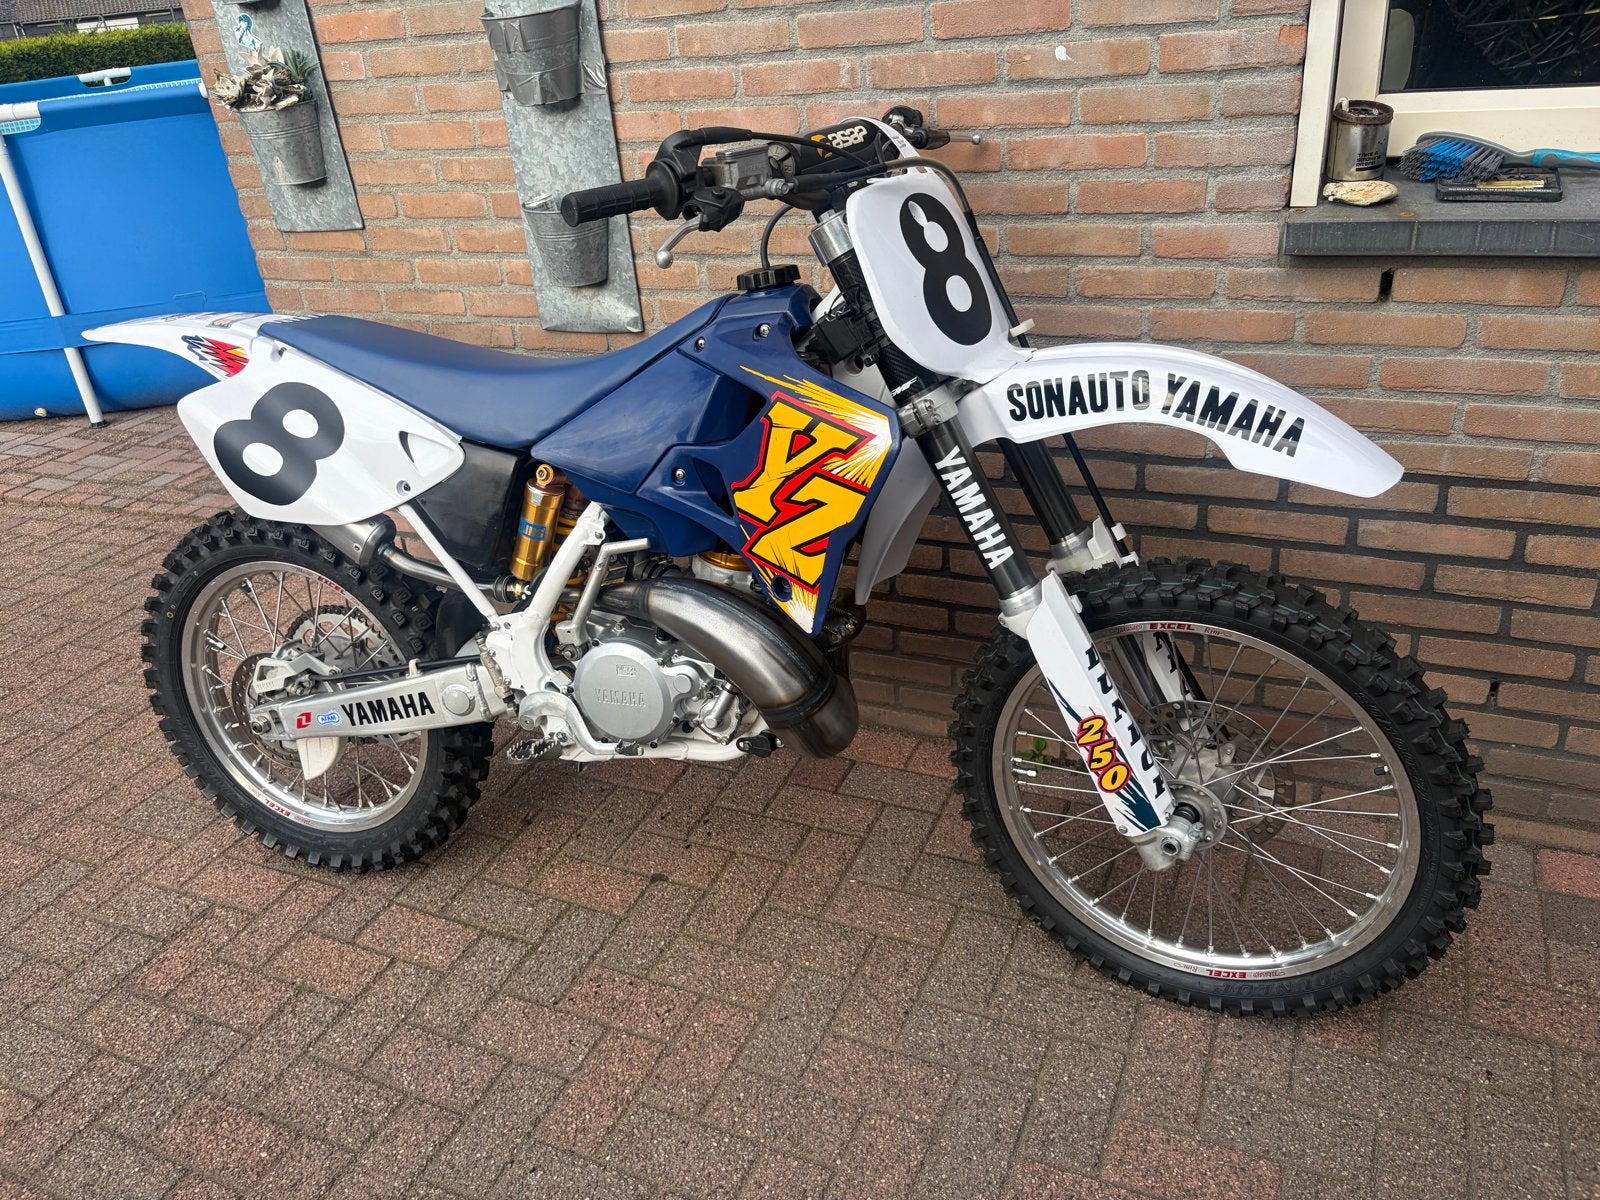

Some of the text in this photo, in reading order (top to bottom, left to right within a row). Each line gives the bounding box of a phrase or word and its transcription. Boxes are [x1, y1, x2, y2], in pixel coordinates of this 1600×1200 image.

[899, 192, 993, 346] 8
[1006, 369, 1306, 458] SONAUTO YAMAHA
[213, 381, 346, 506] 8
[934, 445, 1015, 570] YAMAHA
[1149, 622, 1195, 631] EXCEL
[340, 691, 436, 727] YAMAHA
[594, 687, 647, 708] YAMAHA
[1075, 715, 1132, 793] 250
[265, 798, 291, 817] EXCEL
[1205, 968, 1247, 979] EXCEL
